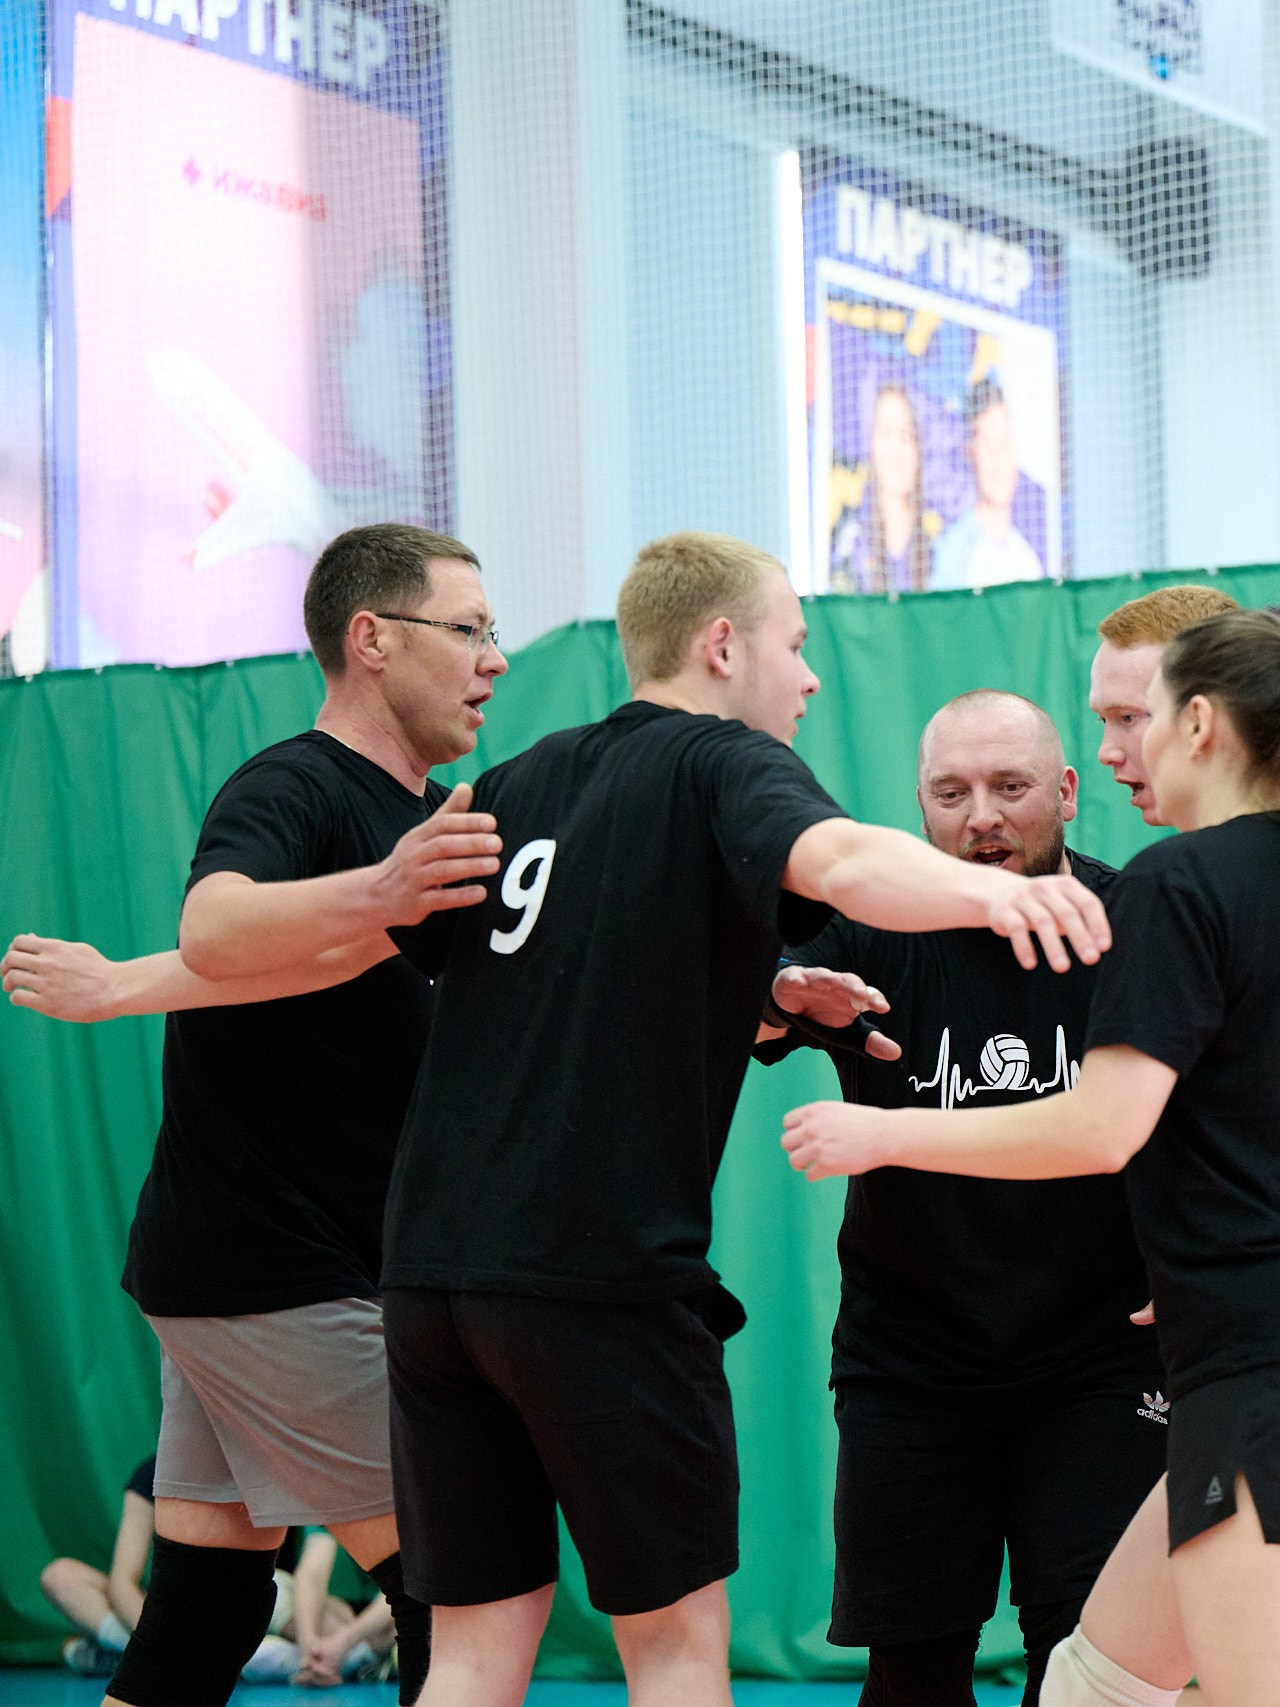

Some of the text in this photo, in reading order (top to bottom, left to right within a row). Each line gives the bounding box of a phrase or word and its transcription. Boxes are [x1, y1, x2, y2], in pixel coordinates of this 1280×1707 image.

[109, 0, 388, 90] РТНЕР
[836, 184, 1033, 307] ПАРТНЕР
[490, 839, 556, 954] 9
[1137, 1408, 1168, 1425] adidas
